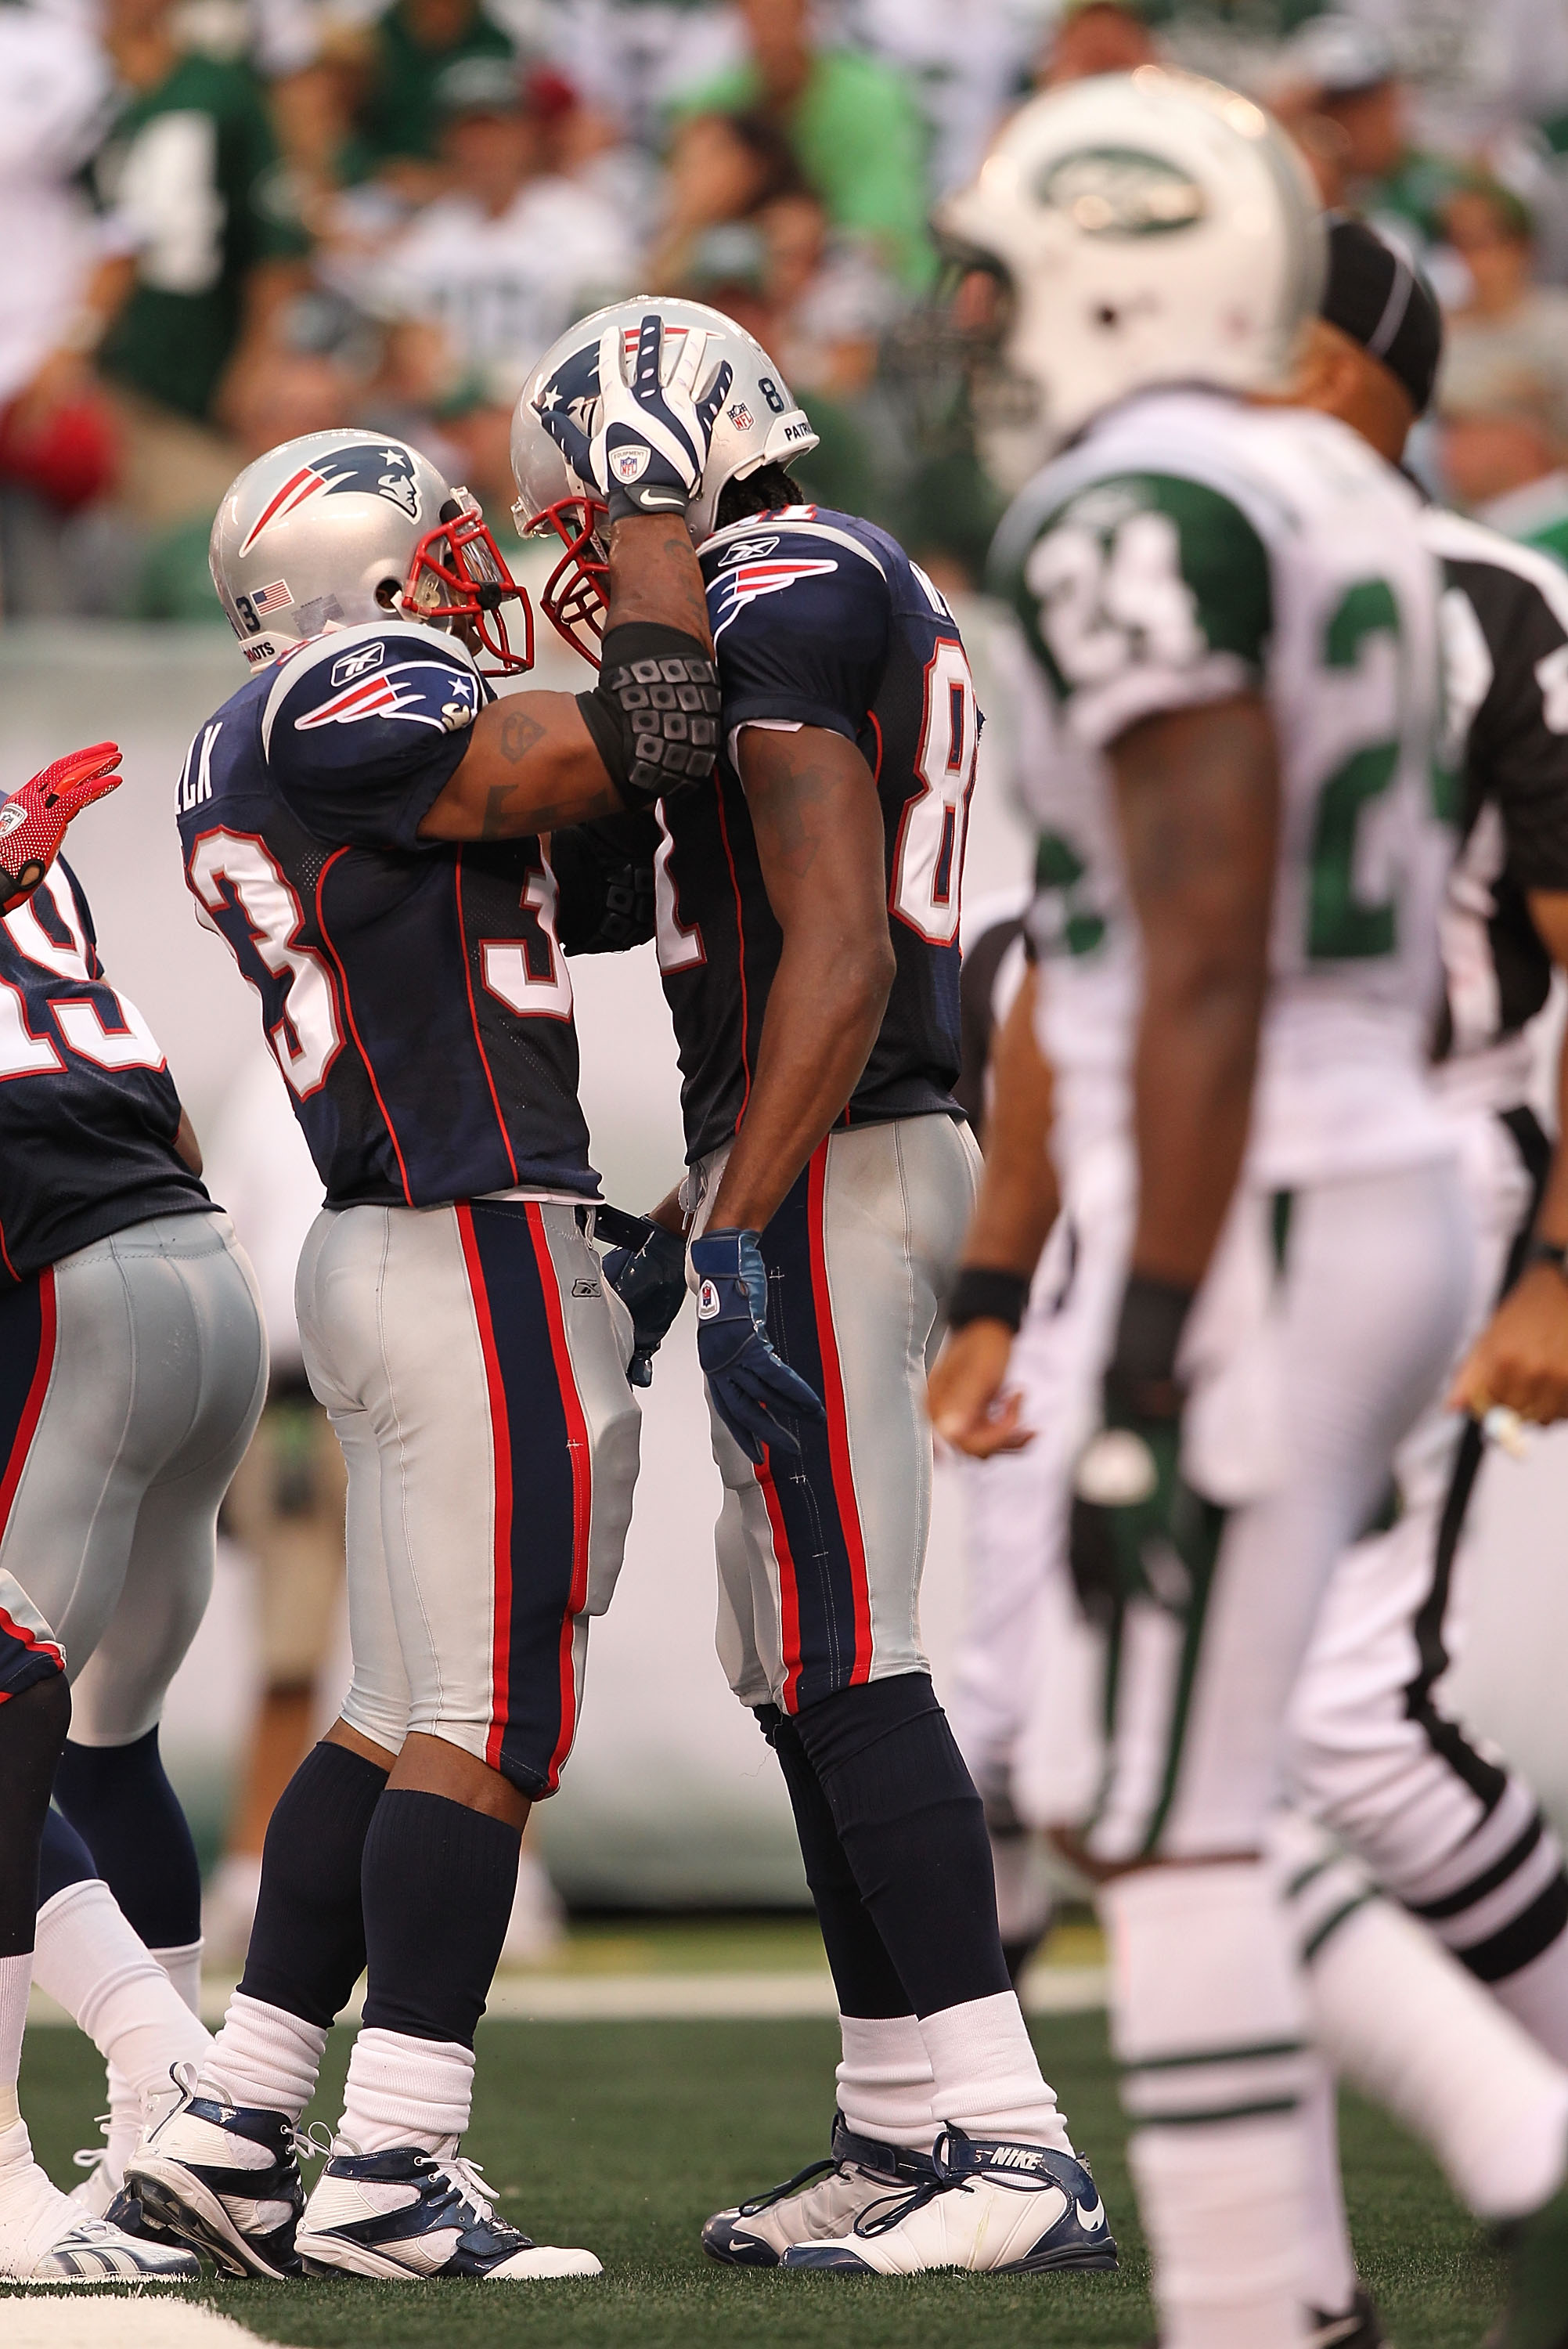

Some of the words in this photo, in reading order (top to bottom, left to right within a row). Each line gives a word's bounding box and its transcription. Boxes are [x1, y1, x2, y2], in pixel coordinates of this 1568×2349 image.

[758, 377, 784, 413] 8
[734, 412, 752, 429] NFL
[784, 422, 811, 441] PATR
[614, 450, 644, 460] EQUIPMENT
[621, 464, 637, 477] NFL
[236, 596, 261, 633] 3
[181, 823, 347, 1103] 3
[989, 2146, 1044, 2171] NIKE
